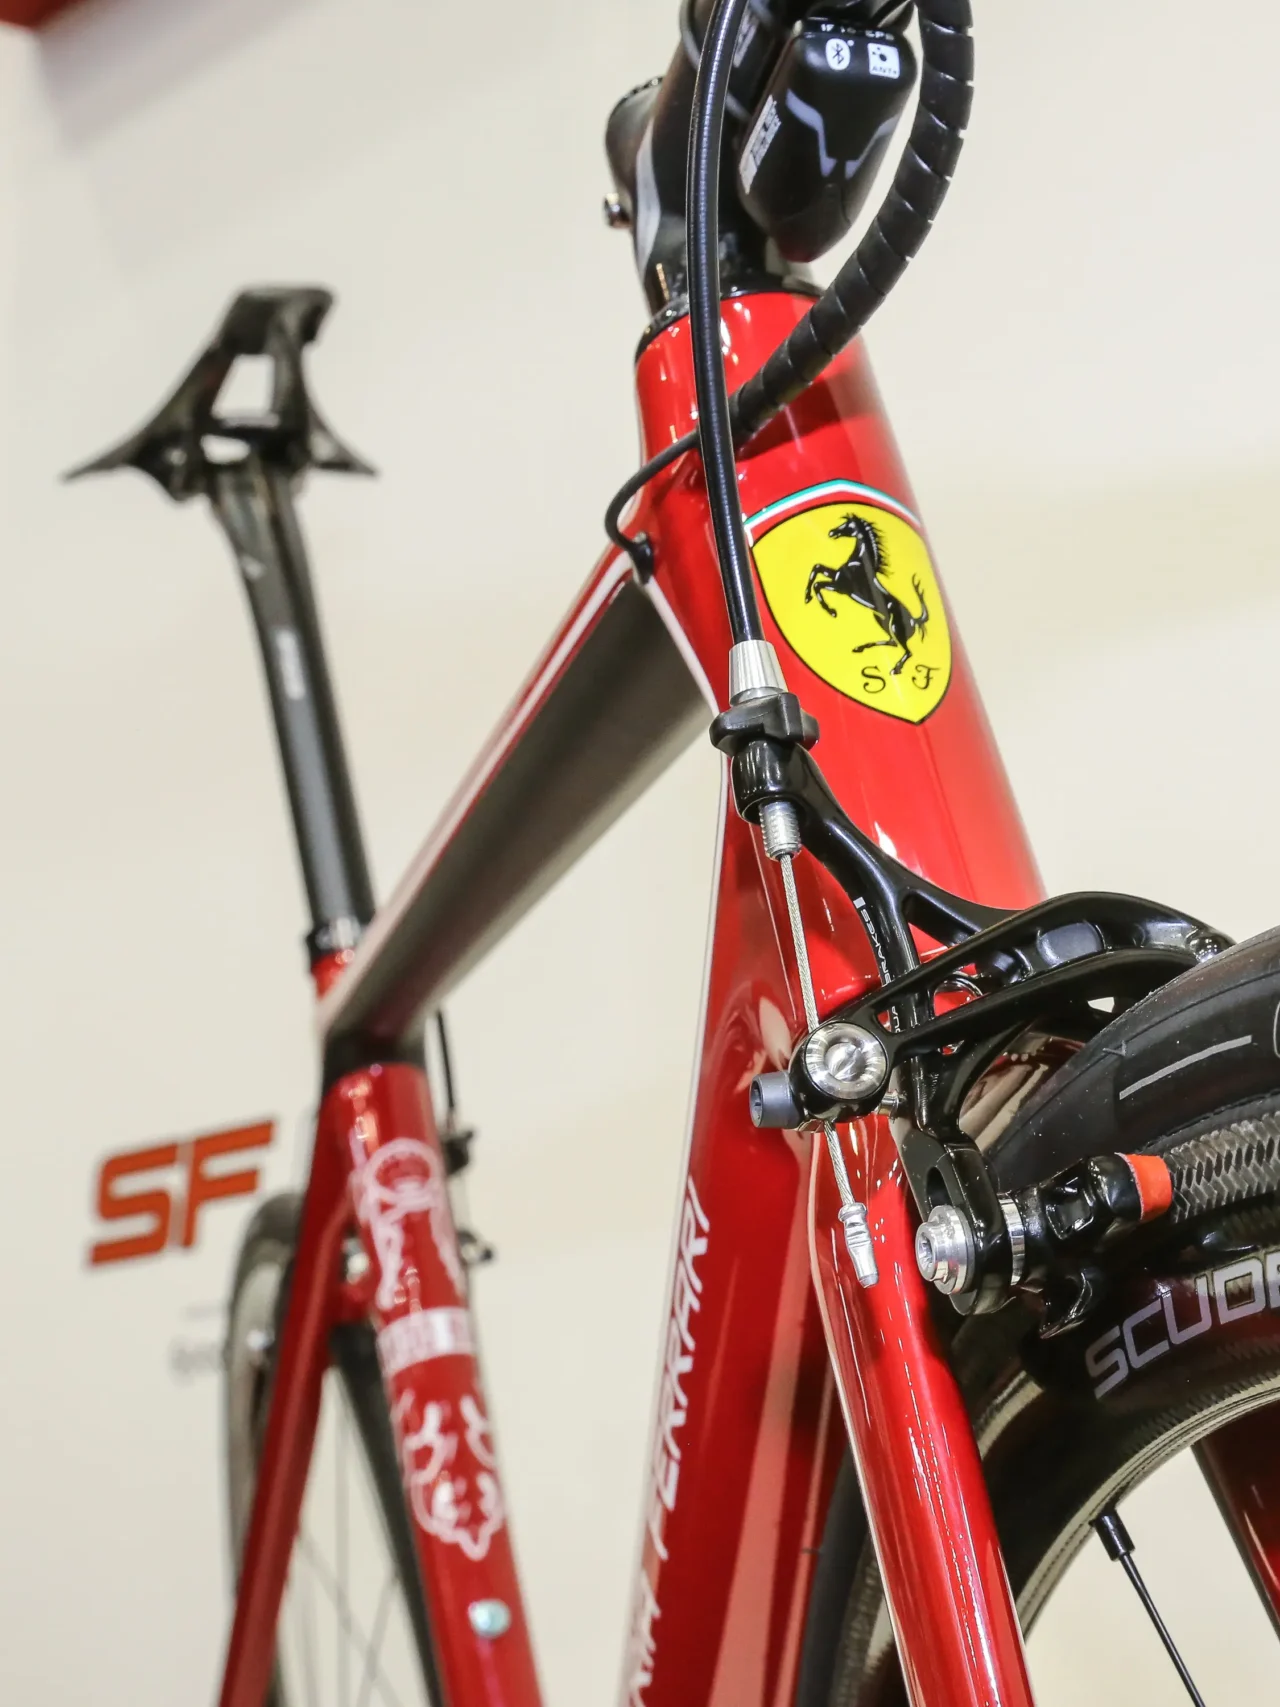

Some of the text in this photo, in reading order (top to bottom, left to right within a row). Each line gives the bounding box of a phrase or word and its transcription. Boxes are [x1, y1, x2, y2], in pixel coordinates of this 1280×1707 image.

[861, 664, 940, 694] S F
[90, 1119, 275, 1266] SF
